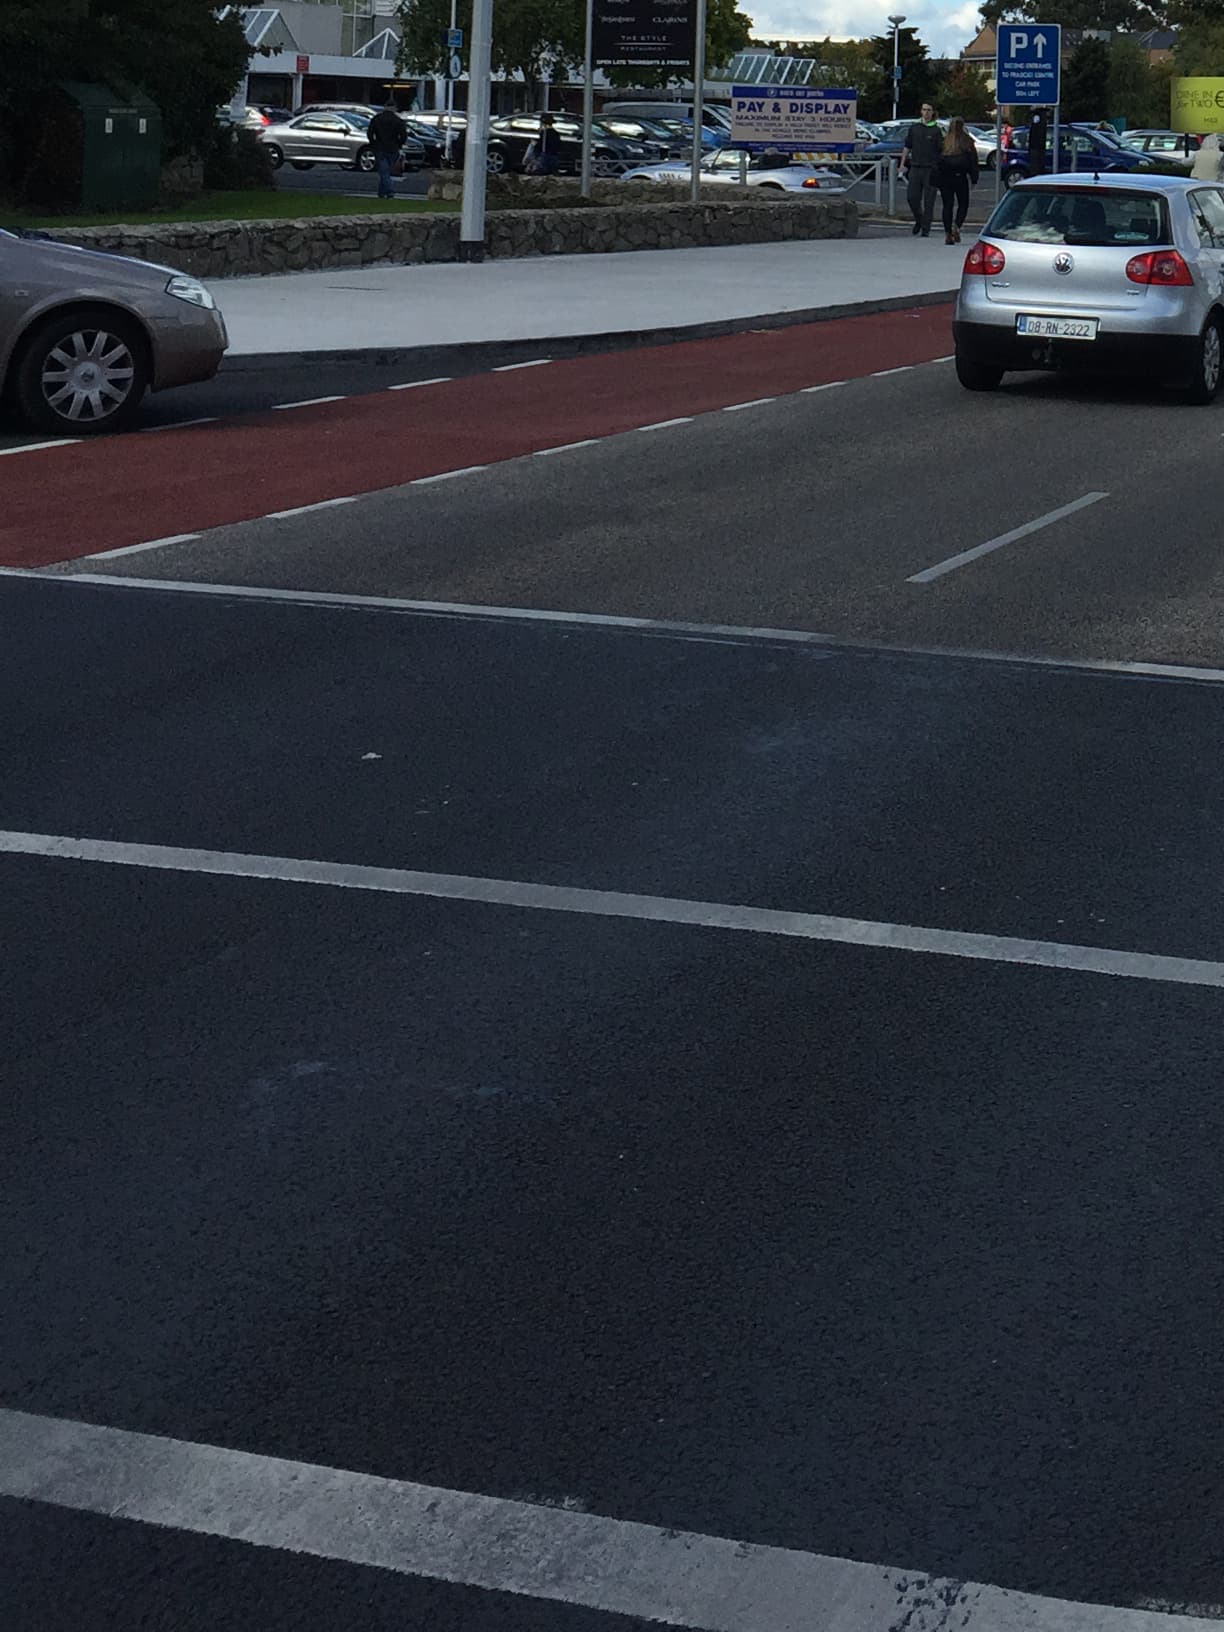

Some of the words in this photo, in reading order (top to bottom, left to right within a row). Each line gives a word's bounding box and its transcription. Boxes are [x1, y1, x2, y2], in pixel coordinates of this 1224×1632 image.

[1010, 32, 1028, 58] P
[1176, 90, 1200, 99] DINE
[1202, 90, 1213, 98] IN
[737, 101, 765, 113] PAY
[772, 102, 781, 113] &
[789, 102, 851, 114] DISPLAY
[1190, 99, 1213, 108] TWO
